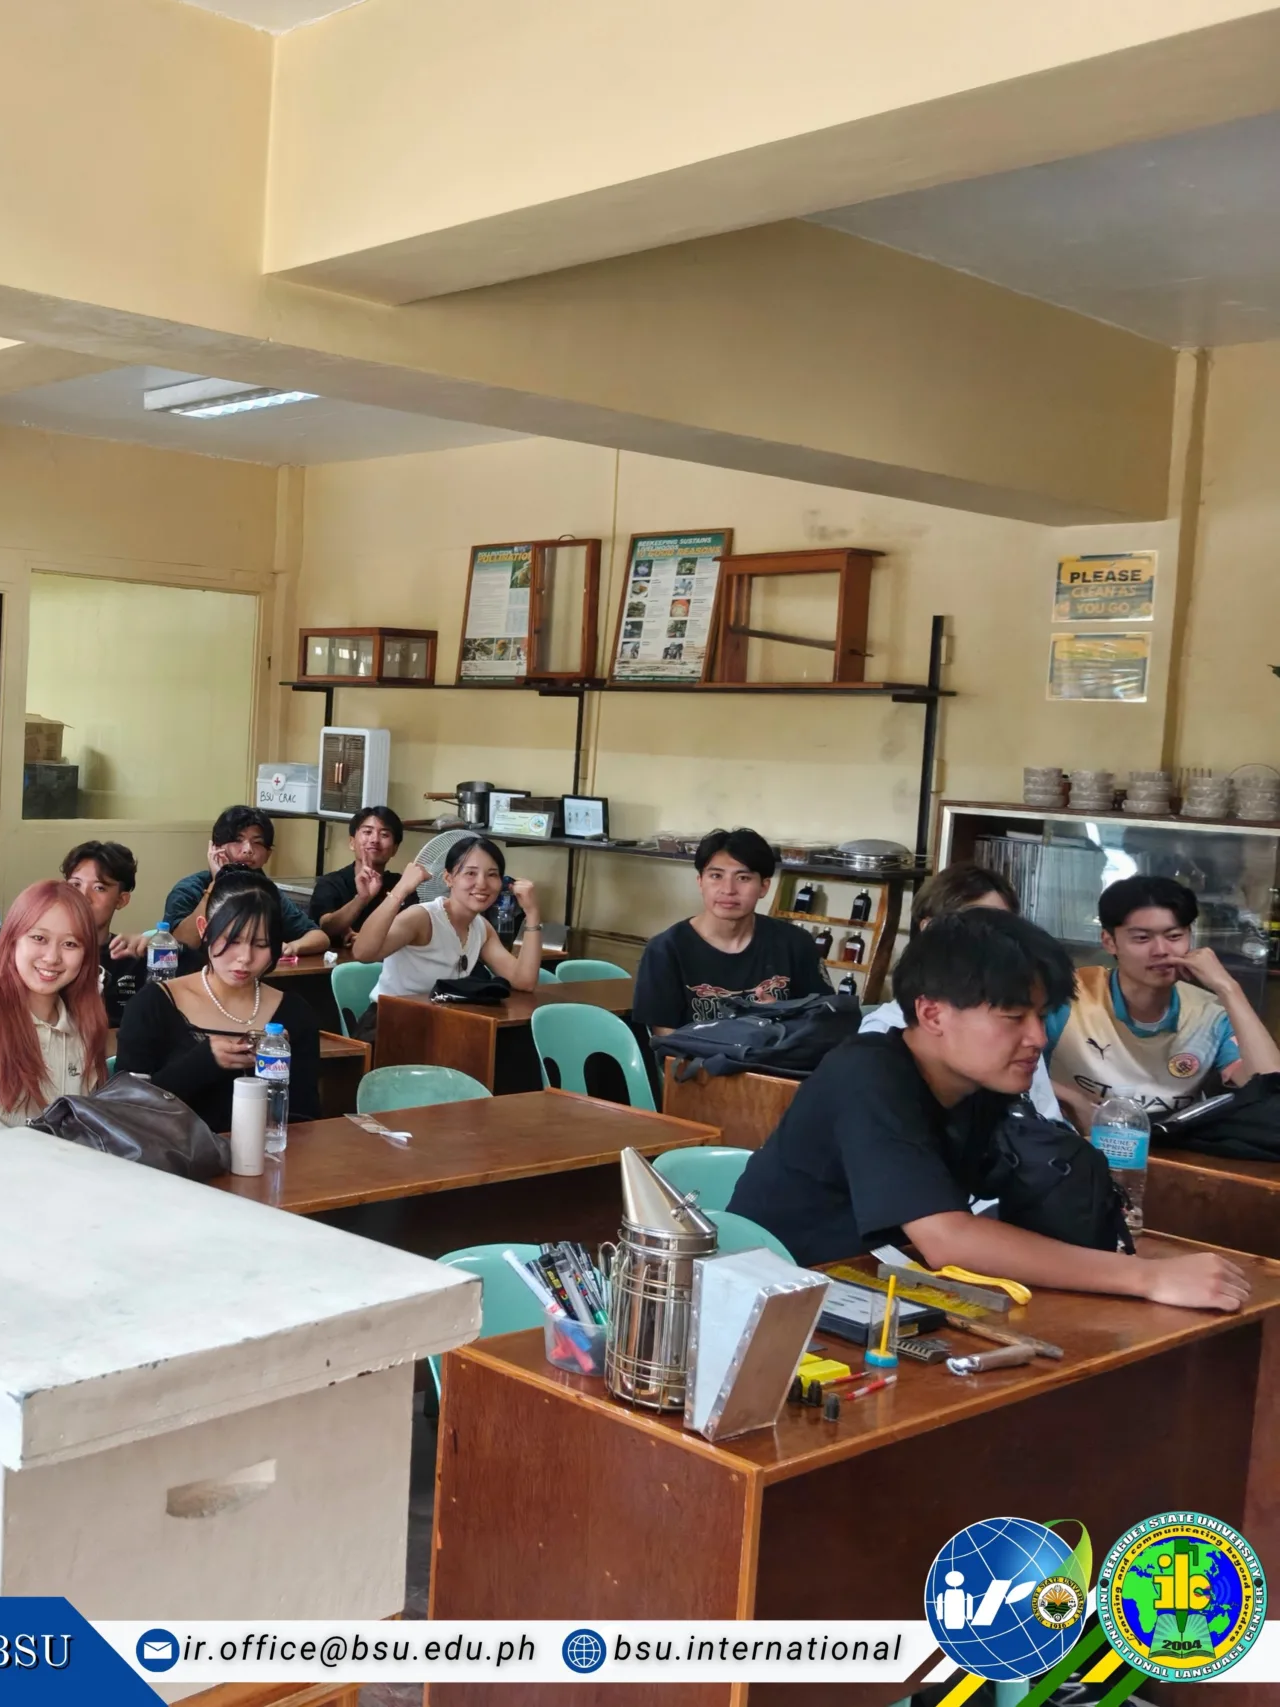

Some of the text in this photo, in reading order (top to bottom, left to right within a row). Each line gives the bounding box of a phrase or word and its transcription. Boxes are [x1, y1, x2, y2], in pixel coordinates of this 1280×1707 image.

[638, 537, 712, 547] BEEKEEPING SUSTAINS
[677, 546, 721, 555] REASONS
[1070, 569, 1142, 583] PLEASE
[1071, 585, 1113, 598] CLEAN
[1076, 602, 1130, 614] YOU GO
[260, 790, 296, 803] BSU CRAC
[1073, 1075, 1194, 1112] ETHAD
[1100, 1136, 1137, 1146] NATURE'S
[1102, 1143, 1133, 1152] SPRING
